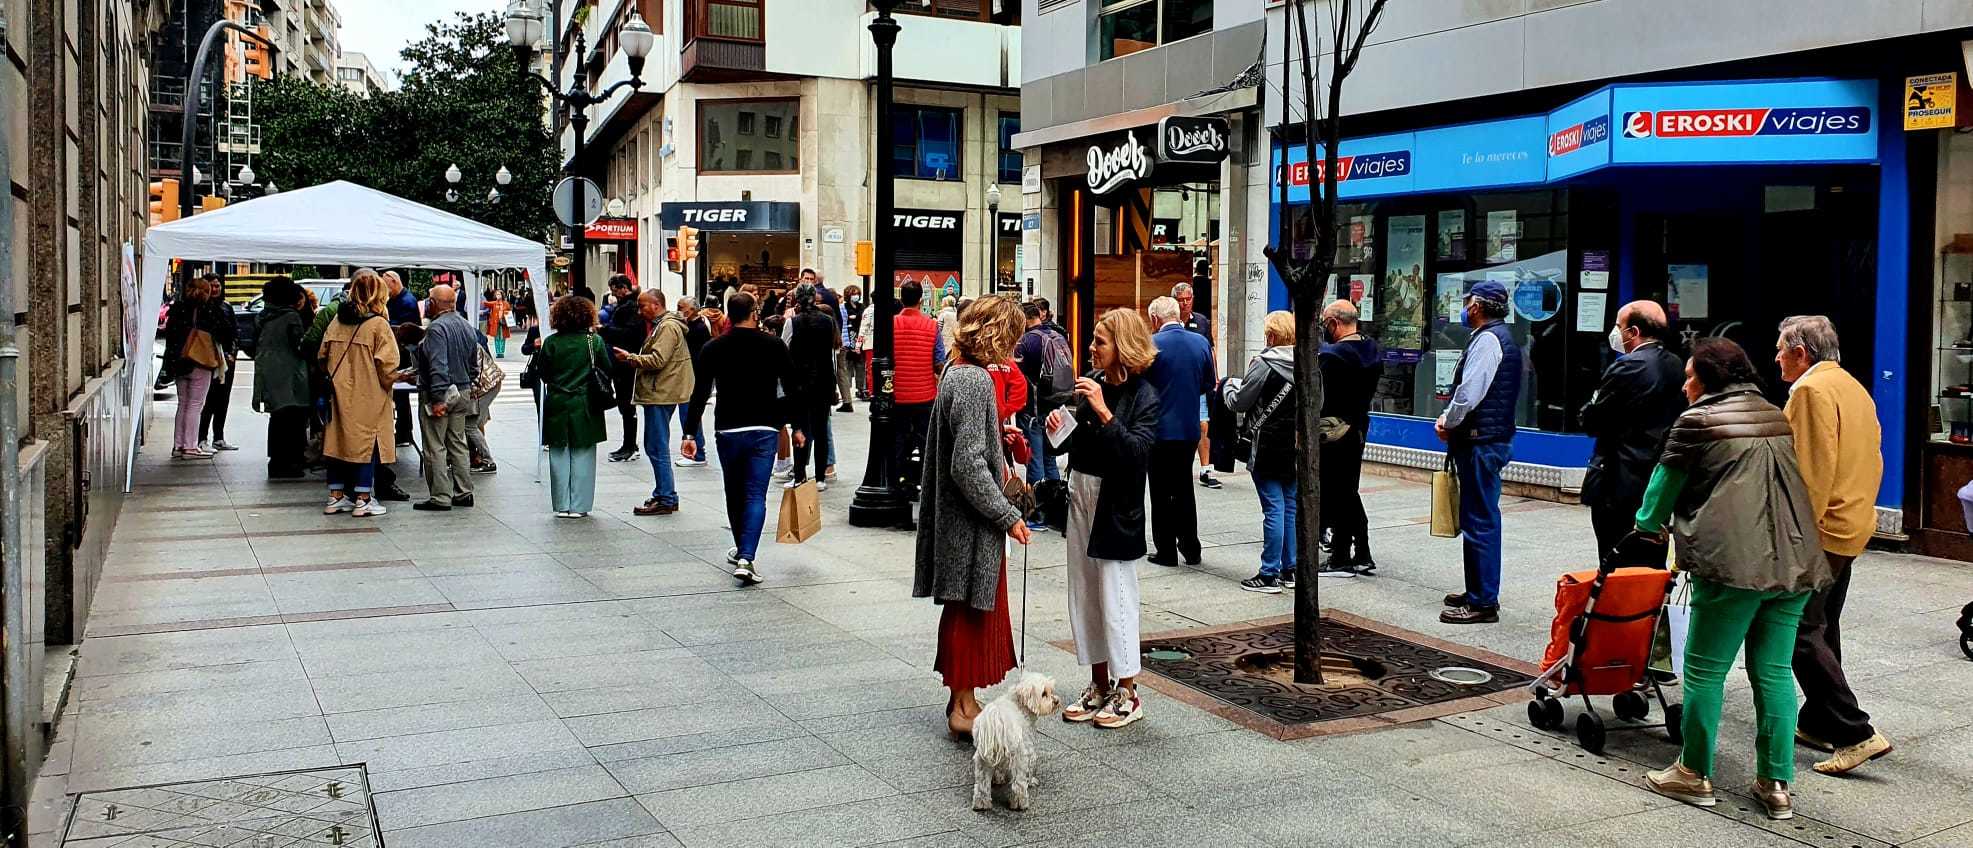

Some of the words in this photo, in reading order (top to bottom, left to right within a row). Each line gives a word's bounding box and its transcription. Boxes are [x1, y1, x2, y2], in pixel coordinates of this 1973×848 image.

[1662, 114, 1751, 132] EROSKI
[1772, 111, 1860, 133] viajes
[1557, 130, 1579, 151] EROSKI
[1583, 121, 1606, 143] viajes
[1355, 156, 1405, 177] viajes
[682, 209, 747, 222] TIGER
[893, 214, 956, 229] TIGER
